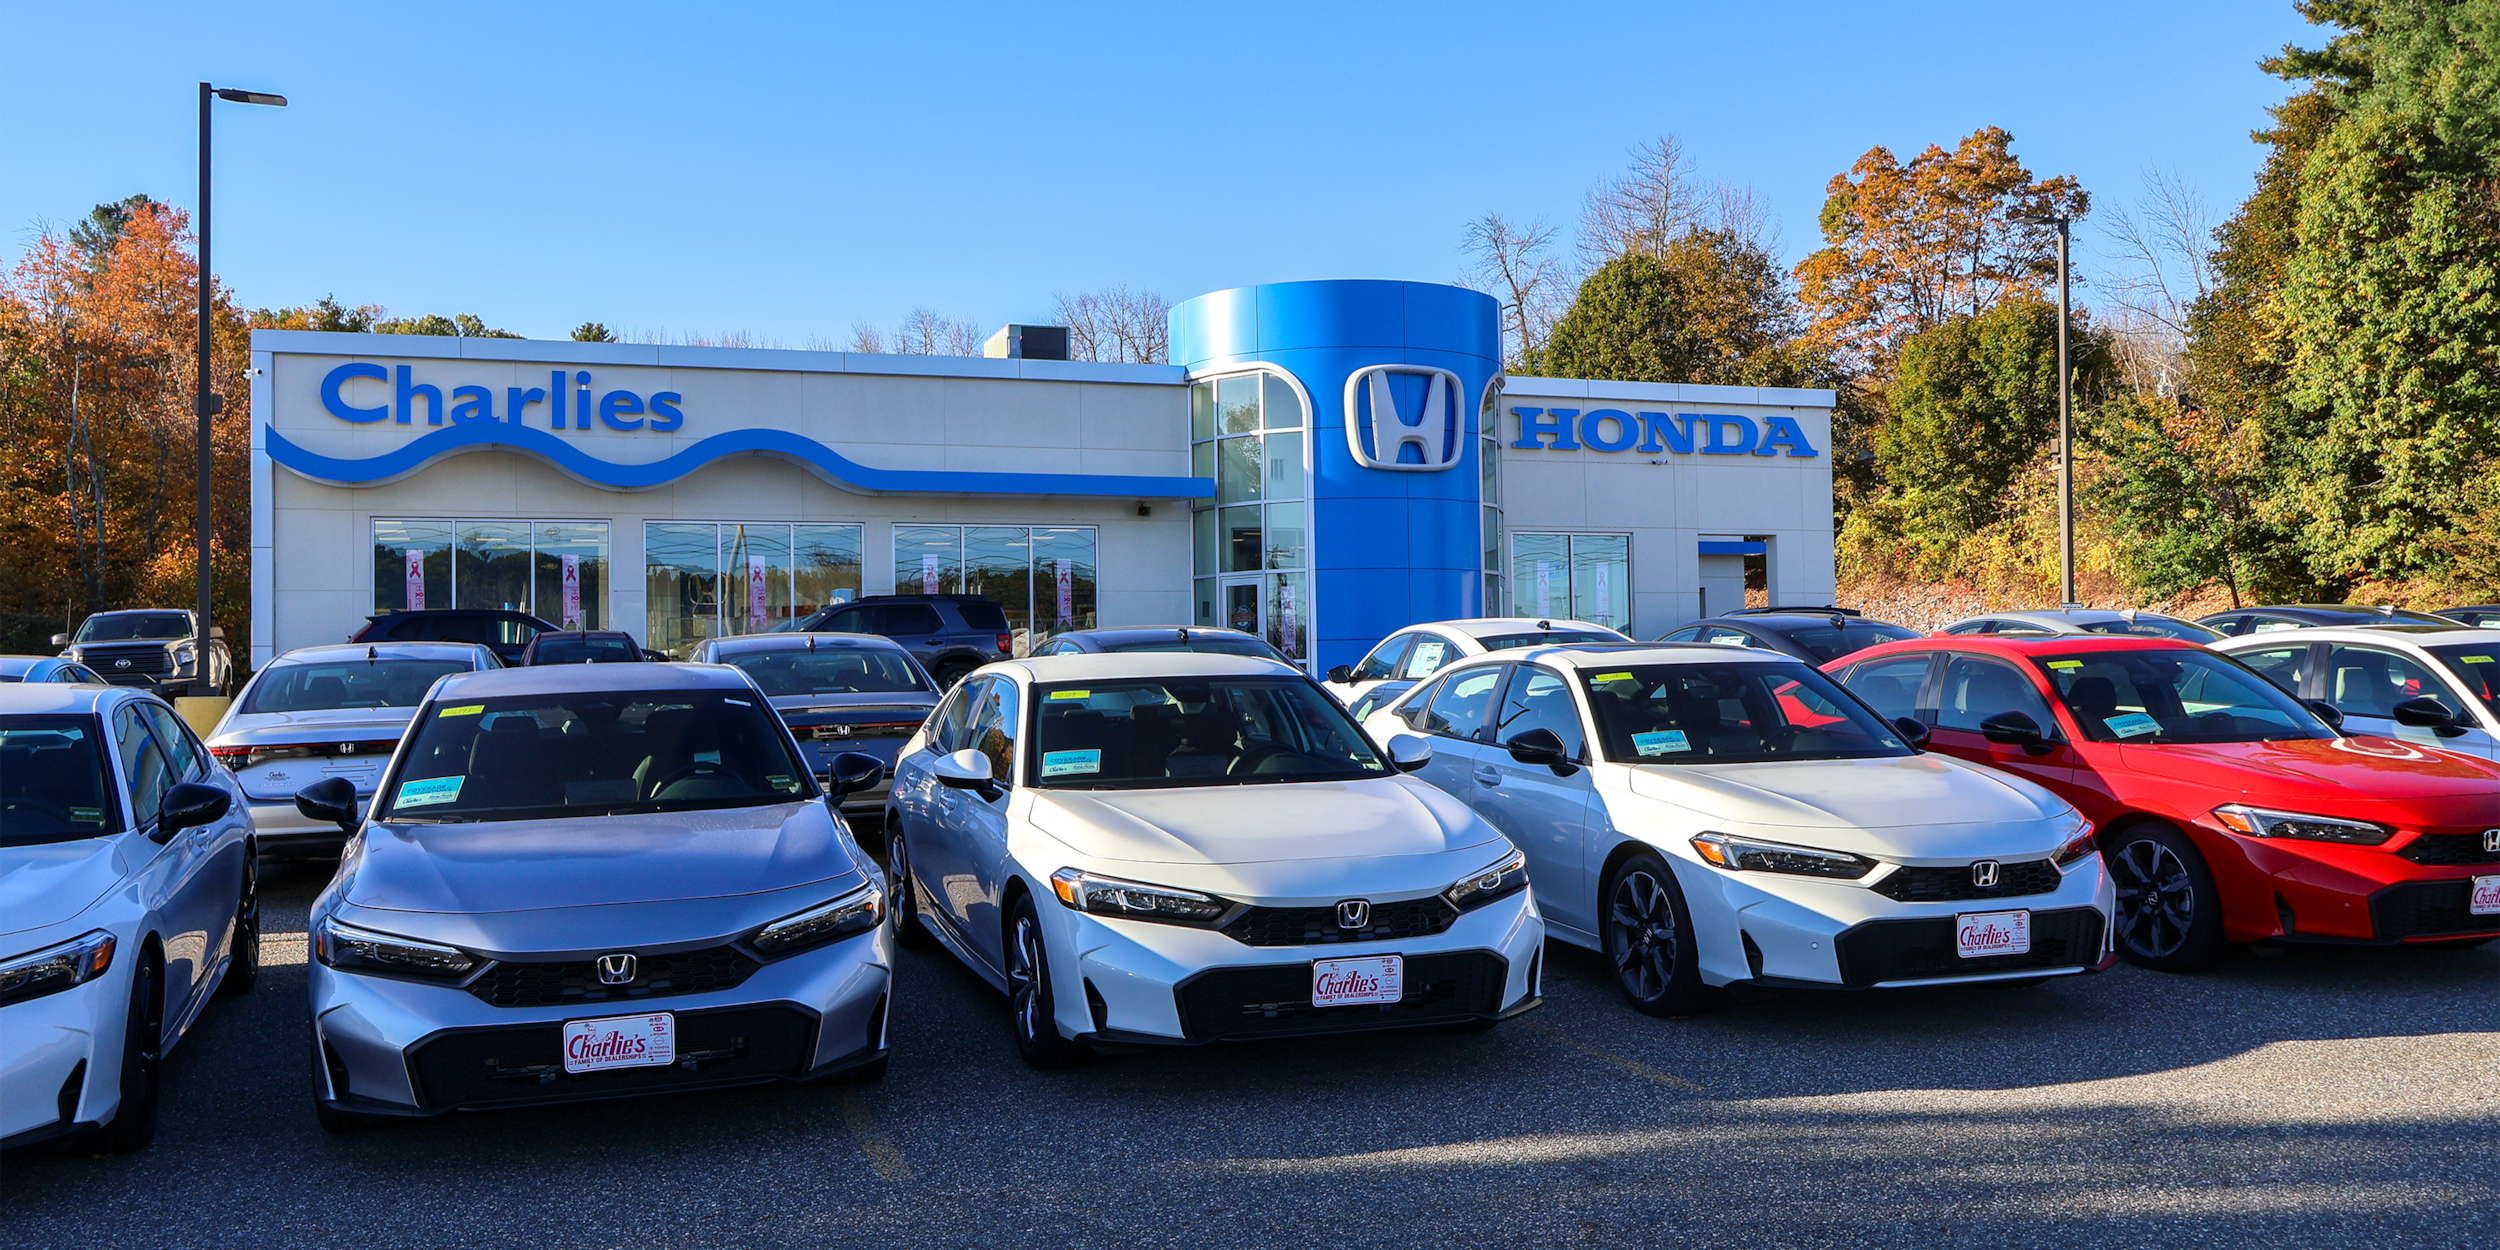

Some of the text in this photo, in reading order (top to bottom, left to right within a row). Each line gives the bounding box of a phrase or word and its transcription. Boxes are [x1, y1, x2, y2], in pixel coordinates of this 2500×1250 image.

[320, 362, 684, 432] Charlies
[1511, 406, 1819, 457] HONDA
[1640, 736, 1673, 744] COVERAGE
[406, 784, 447, 794] COVERAGE
[1960, 924, 2011, 946] Charlie's
[1316, 970, 1379, 995] Charlie's
[1319, 993, 1336, 1001] FAMILY
[1344, 991, 1374, 999] DEALERSHIPS
[568, 1030, 647, 1060] Charlie's
[574, 1057, 595, 1066] FAMILY
[604, 1053, 642, 1062] DEALERSHIPS
